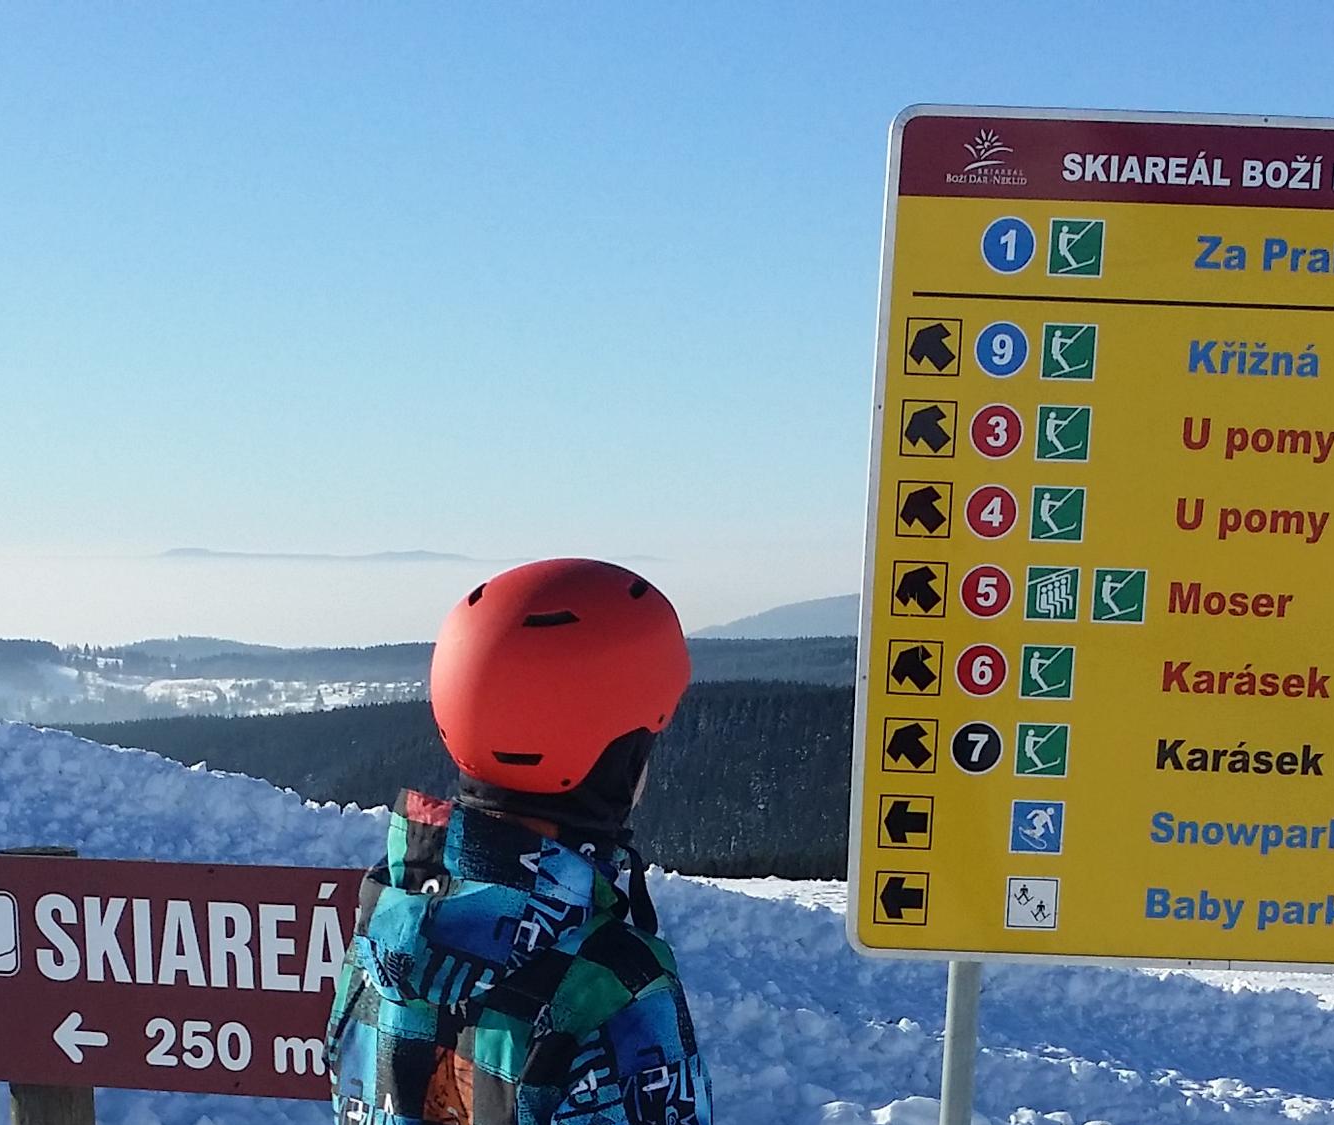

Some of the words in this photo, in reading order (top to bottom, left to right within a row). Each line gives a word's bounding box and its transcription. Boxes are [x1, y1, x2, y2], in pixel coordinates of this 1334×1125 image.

[1062, 151, 1231, 186] SKIAREÁL
[1242, 155, 1323, 189] BOŽÍ
[1000, 229, 1016, 260] 1
[1194, 235, 1247, 271] Za
[992, 334, 1013, 365] 9
[1188, 340, 1320, 378] Křižná
[986, 416, 1008, 447] 3
[1182, 416, 1212, 451] U
[980, 496, 1003, 527] 4
[1176, 497, 1205, 531] U
[1218, 507, 1330, 545] pomy
[976, 577, 998, 607] 5
[1167, 581, 1294, 618] Moser
[971, 655, 993, 685] 6
[1161, 660, 1332, 699] Karásek
[966, 733, 989, 763] 7
[1156, 738, 1324, 776] Karásek
[1145, 887, 1244, 930] Baby
[34, 883, 362, 992] SKIAREÁ
[145, 1017, 252, 1071] 250
[274, 1036, 326, 1076] m
